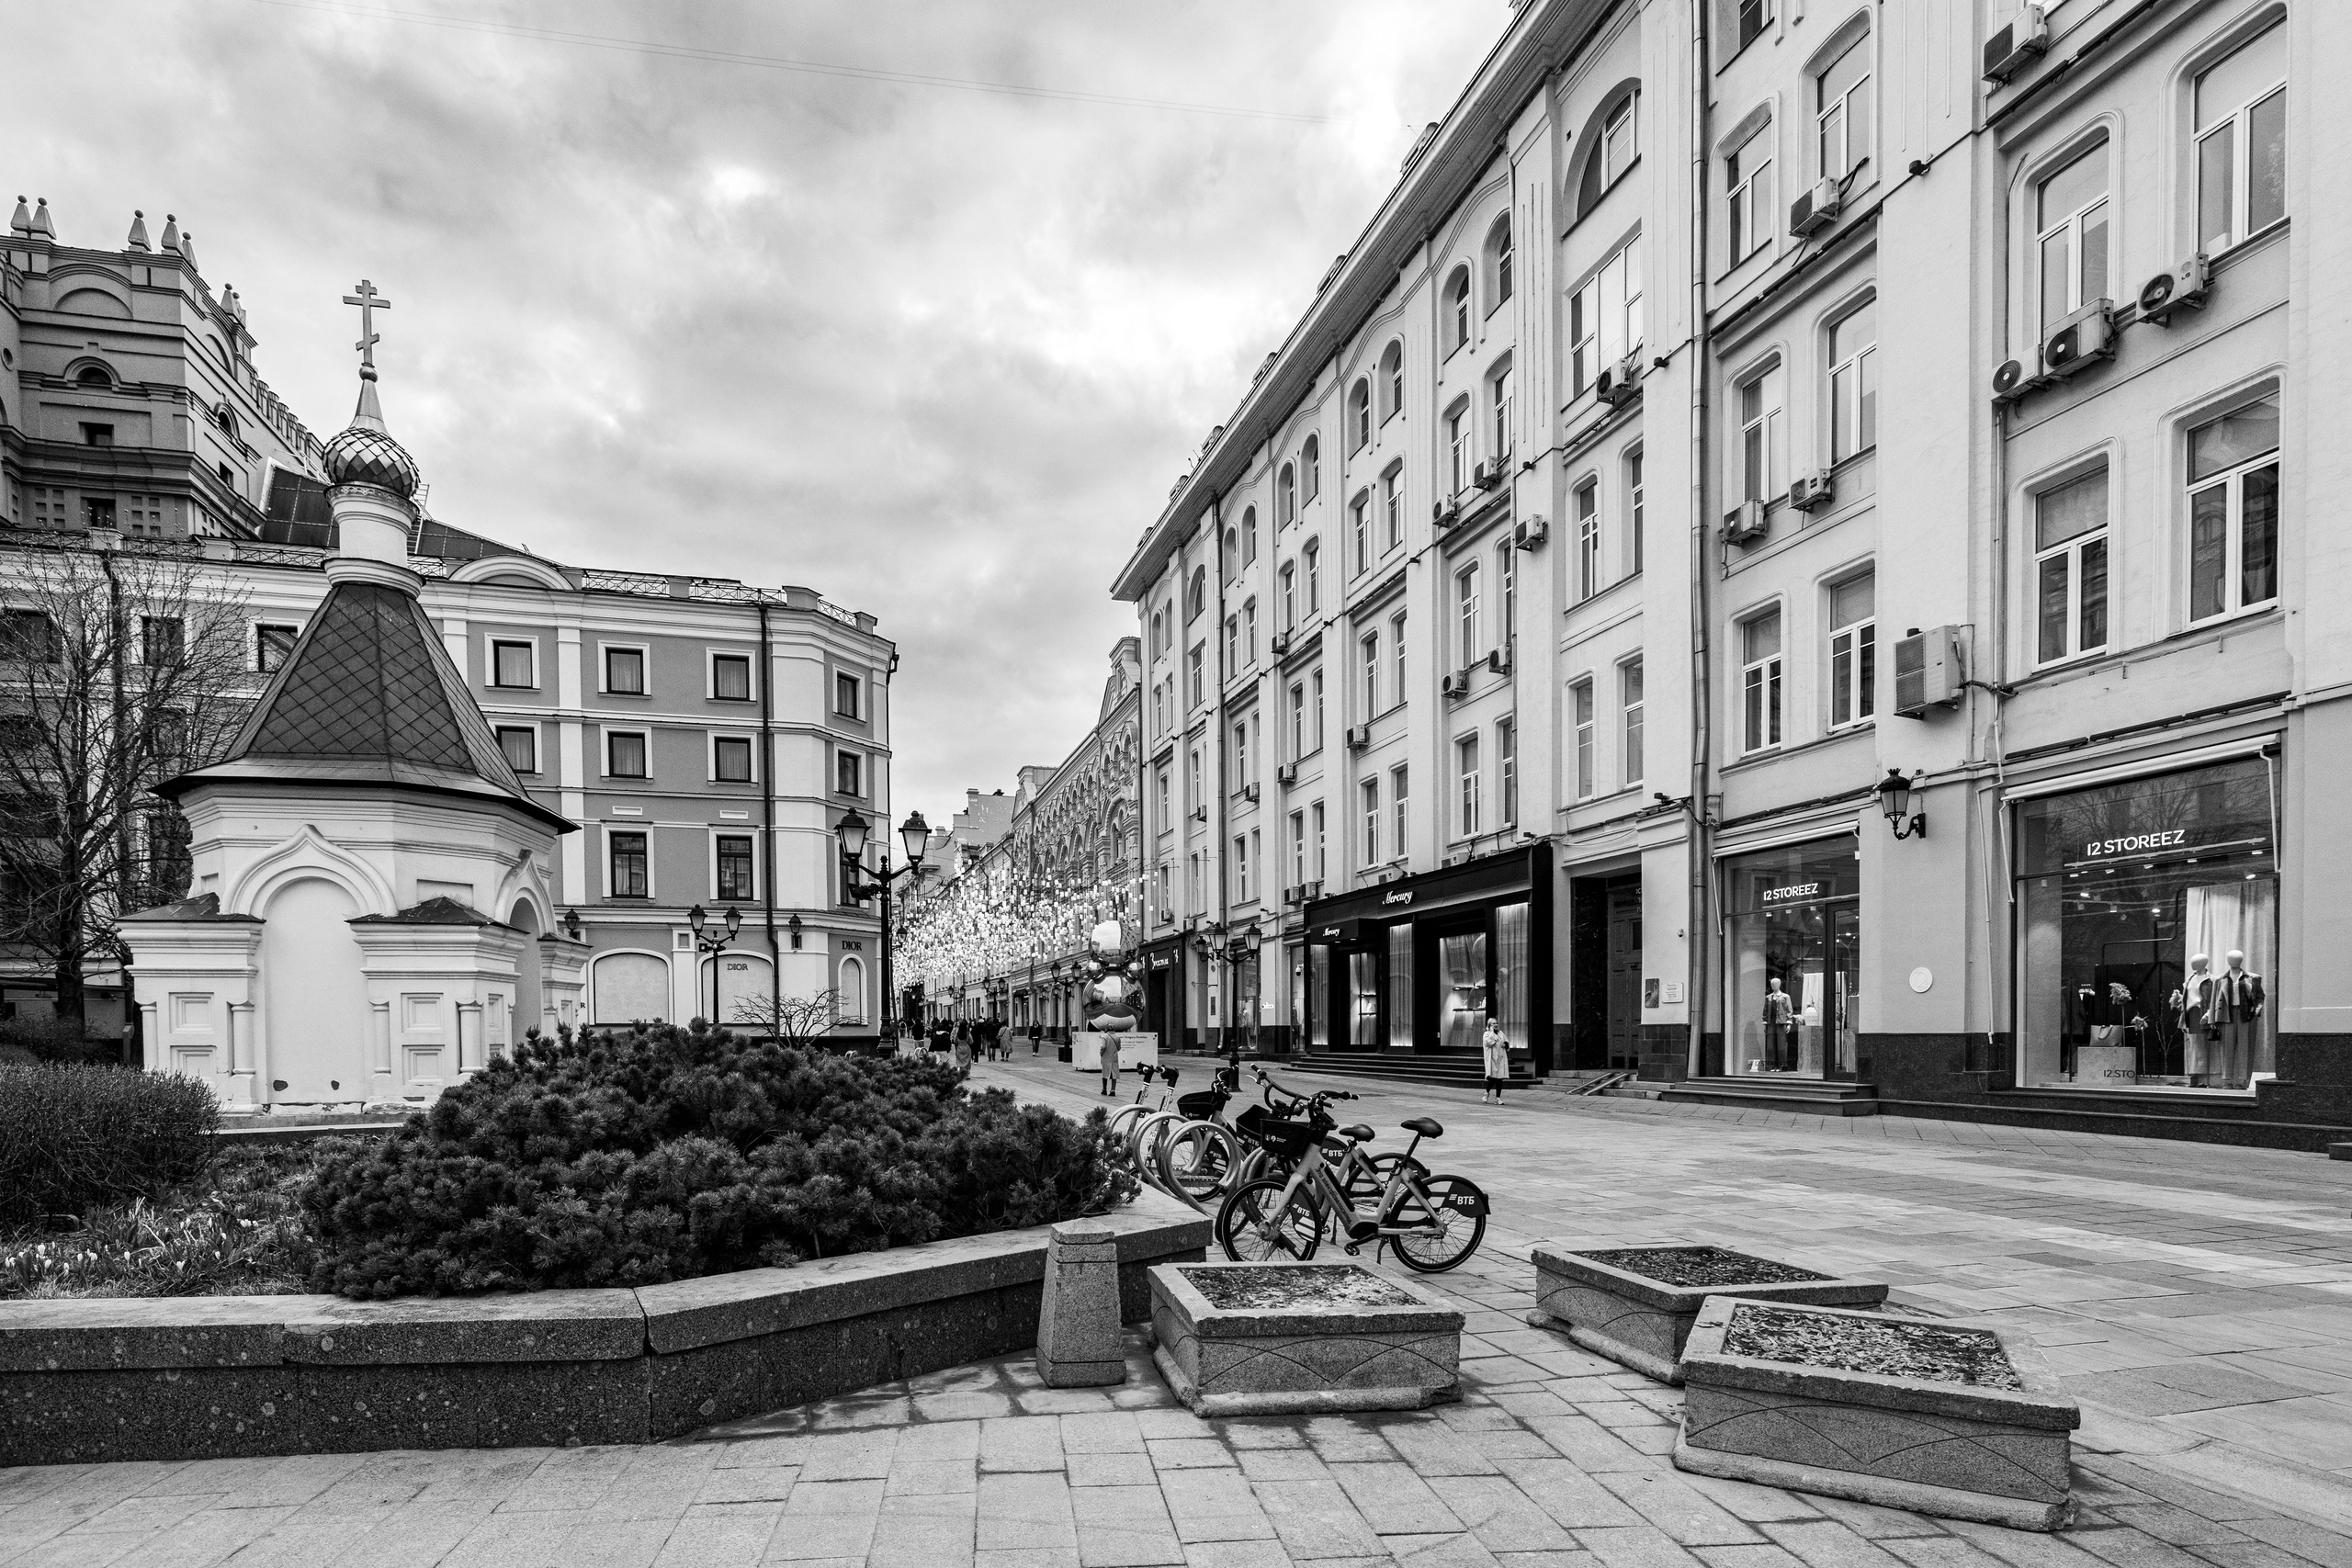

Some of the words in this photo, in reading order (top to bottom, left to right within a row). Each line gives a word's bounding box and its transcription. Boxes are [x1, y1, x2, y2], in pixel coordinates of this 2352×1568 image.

[2086, 841, 2101, 856] 12
[2104, 829, 2186, 853] STOREEZ
[1763, 889, 1772, 901] 12
[1772, 882, 1819, 899] STOREEZ
[1382, 890, 1413, 905] Mercury
[1322, 927, 1340, 937] Mercury
[842, 940, 863, 952] DIOR
[727, 963, 749, 971] DIOR
[1329, 1149, 1343, 1157] ВТБ
[1456, 1195, 1475, 1205] ВТБ
[1296, 1206, 1310, 1217] ВТБ
